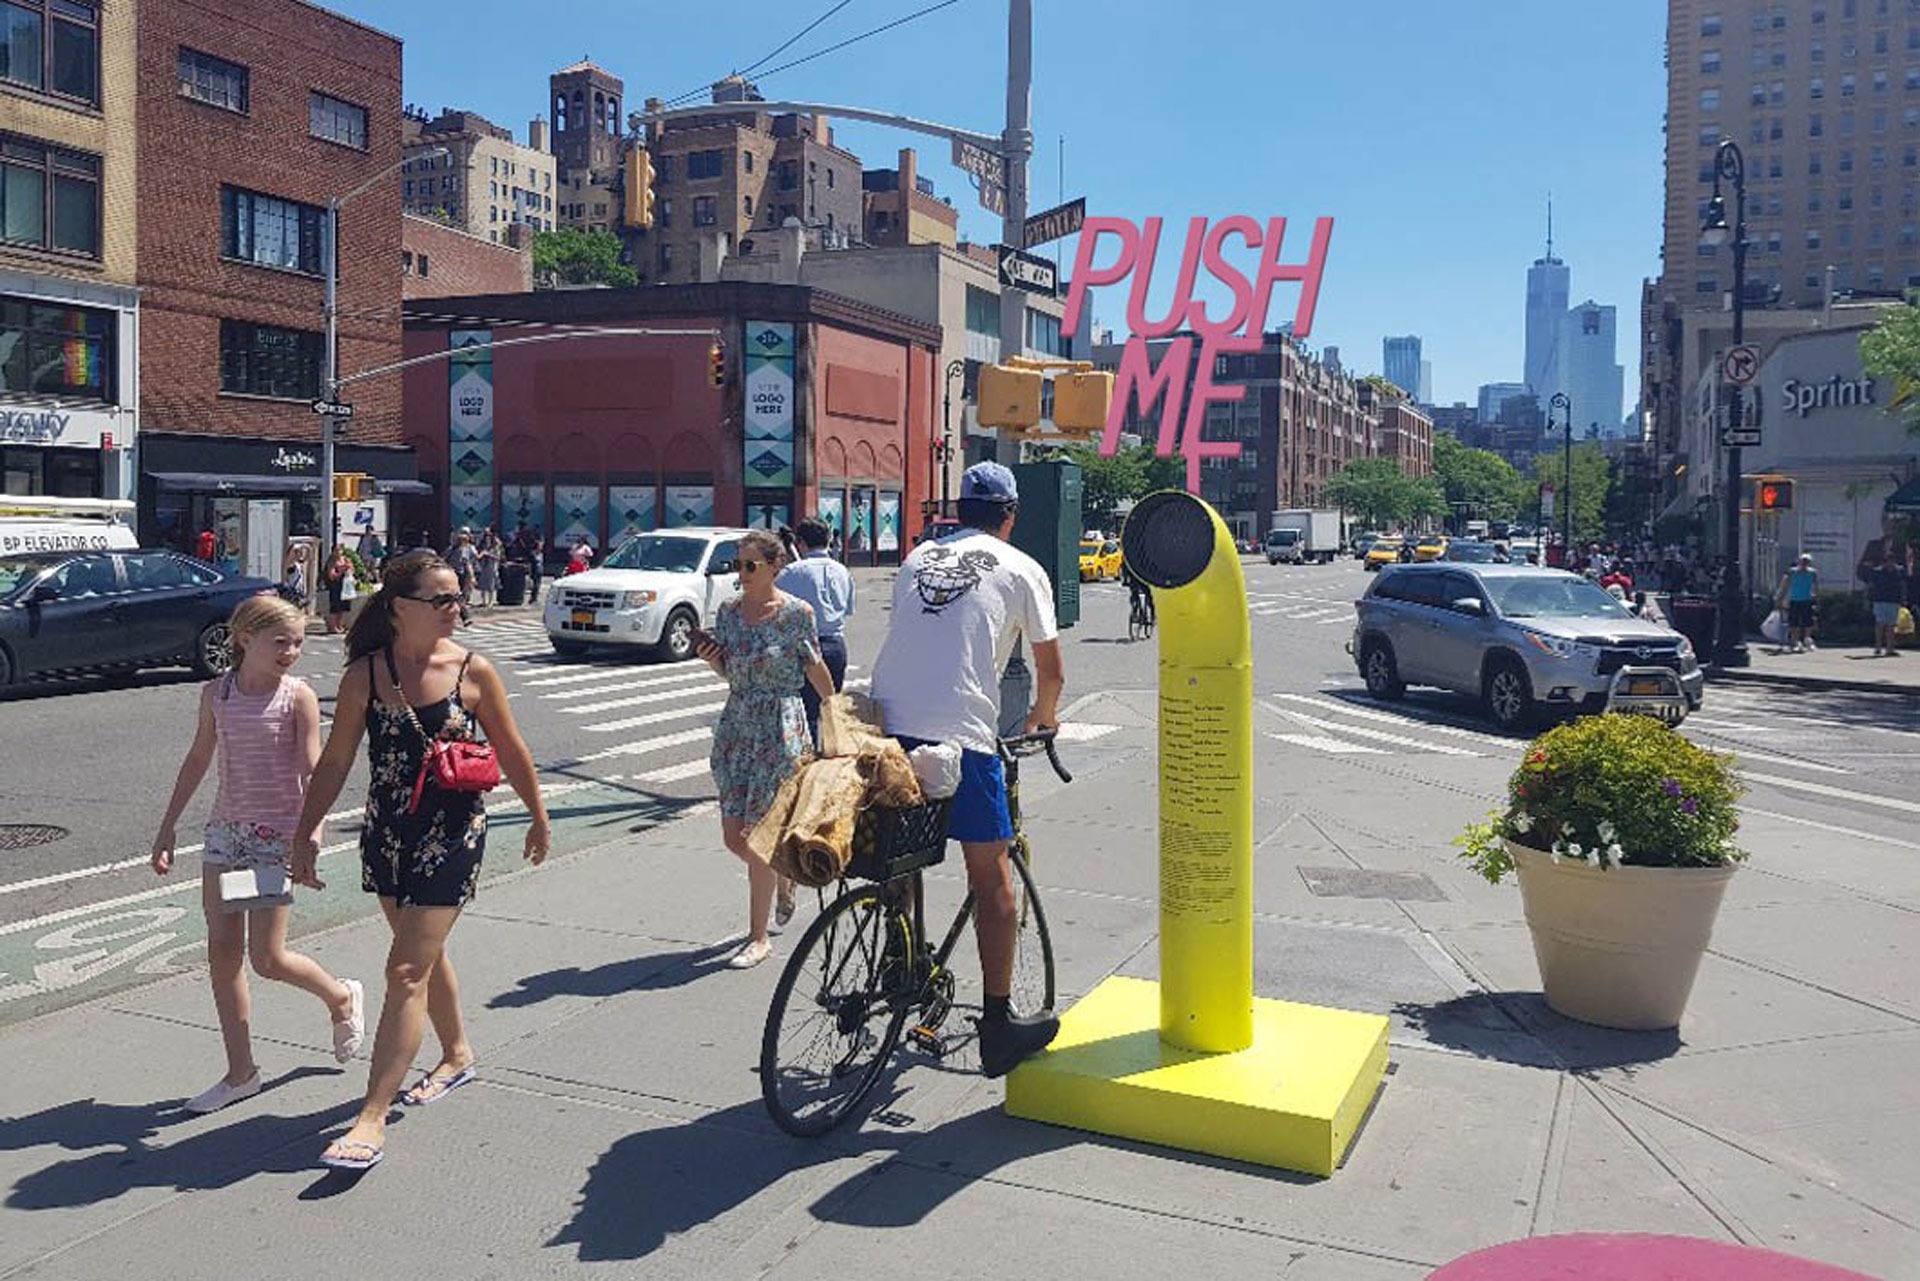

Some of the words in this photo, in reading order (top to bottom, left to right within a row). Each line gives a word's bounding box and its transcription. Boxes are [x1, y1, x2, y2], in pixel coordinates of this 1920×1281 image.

[1007, 258, 1024, 278] ONE
[1061, 216, 1334, 338] PUSH
[459, 397, 484, 407] LOGO
[753, 393, 785, 404] LOGO
[1100, 334, 1263, 458] ME
[1782, 375, 1874, 417] Sprint
[461, 408, 482, 417] HERE
[755, 405, 782, 414] HERE
[4, 536, 20, 551] BP
[25, 536, 87, 550] ELEVATOR
